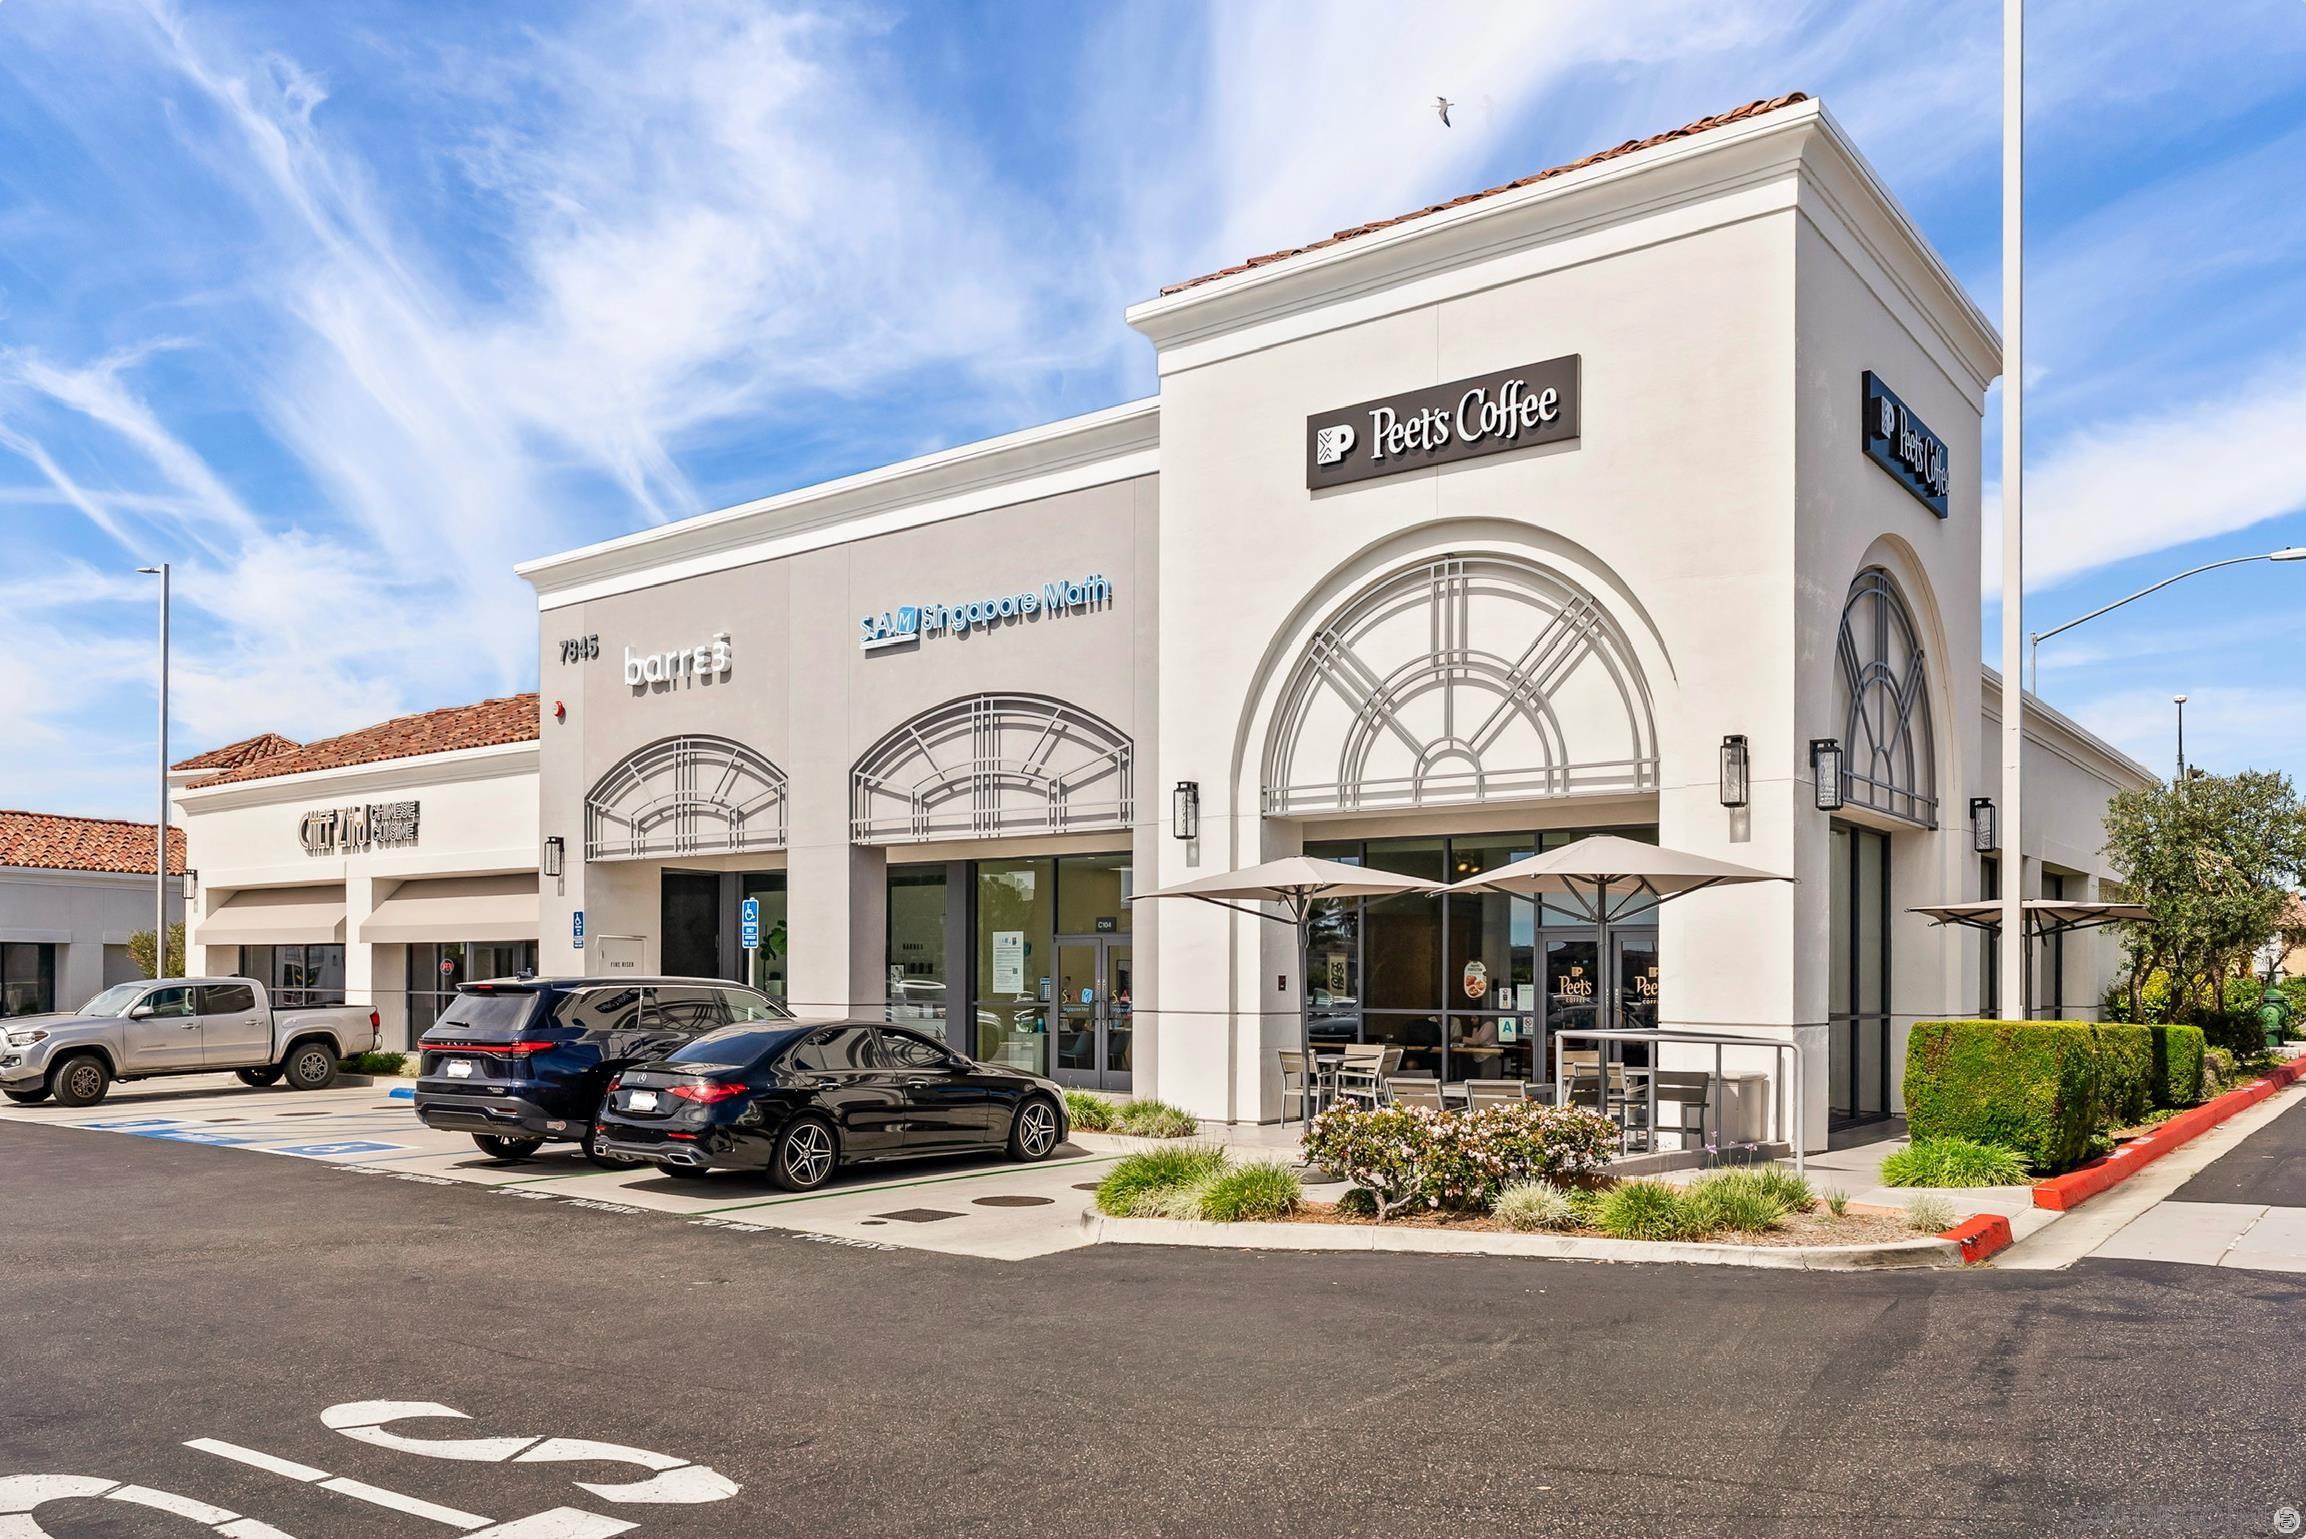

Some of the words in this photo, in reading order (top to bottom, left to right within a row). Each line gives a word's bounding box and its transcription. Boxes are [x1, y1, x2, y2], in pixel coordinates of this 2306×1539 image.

[1368, 407, 1450, 460] Peet's
[1456, 379, 1558, 443] Coffee
[1899, 404, 1924, 473] Peet's
[922, 591, 1040, 632] Singapore
[1043, 575, 1110, 610] Math
[559, 634, 600, 666] 7845
[370, 801, 418, 821] CHINESE
[298, 809, 335, 850] CHEF
[372, 821, 417, 842] CUISINE
[1097, 921, 1112, 929] C104
[1558, 975, 1592, 996] Peet's
[1634, 976, 1659, 996] Pee
[1502, 1020, 1513, 1033] A
